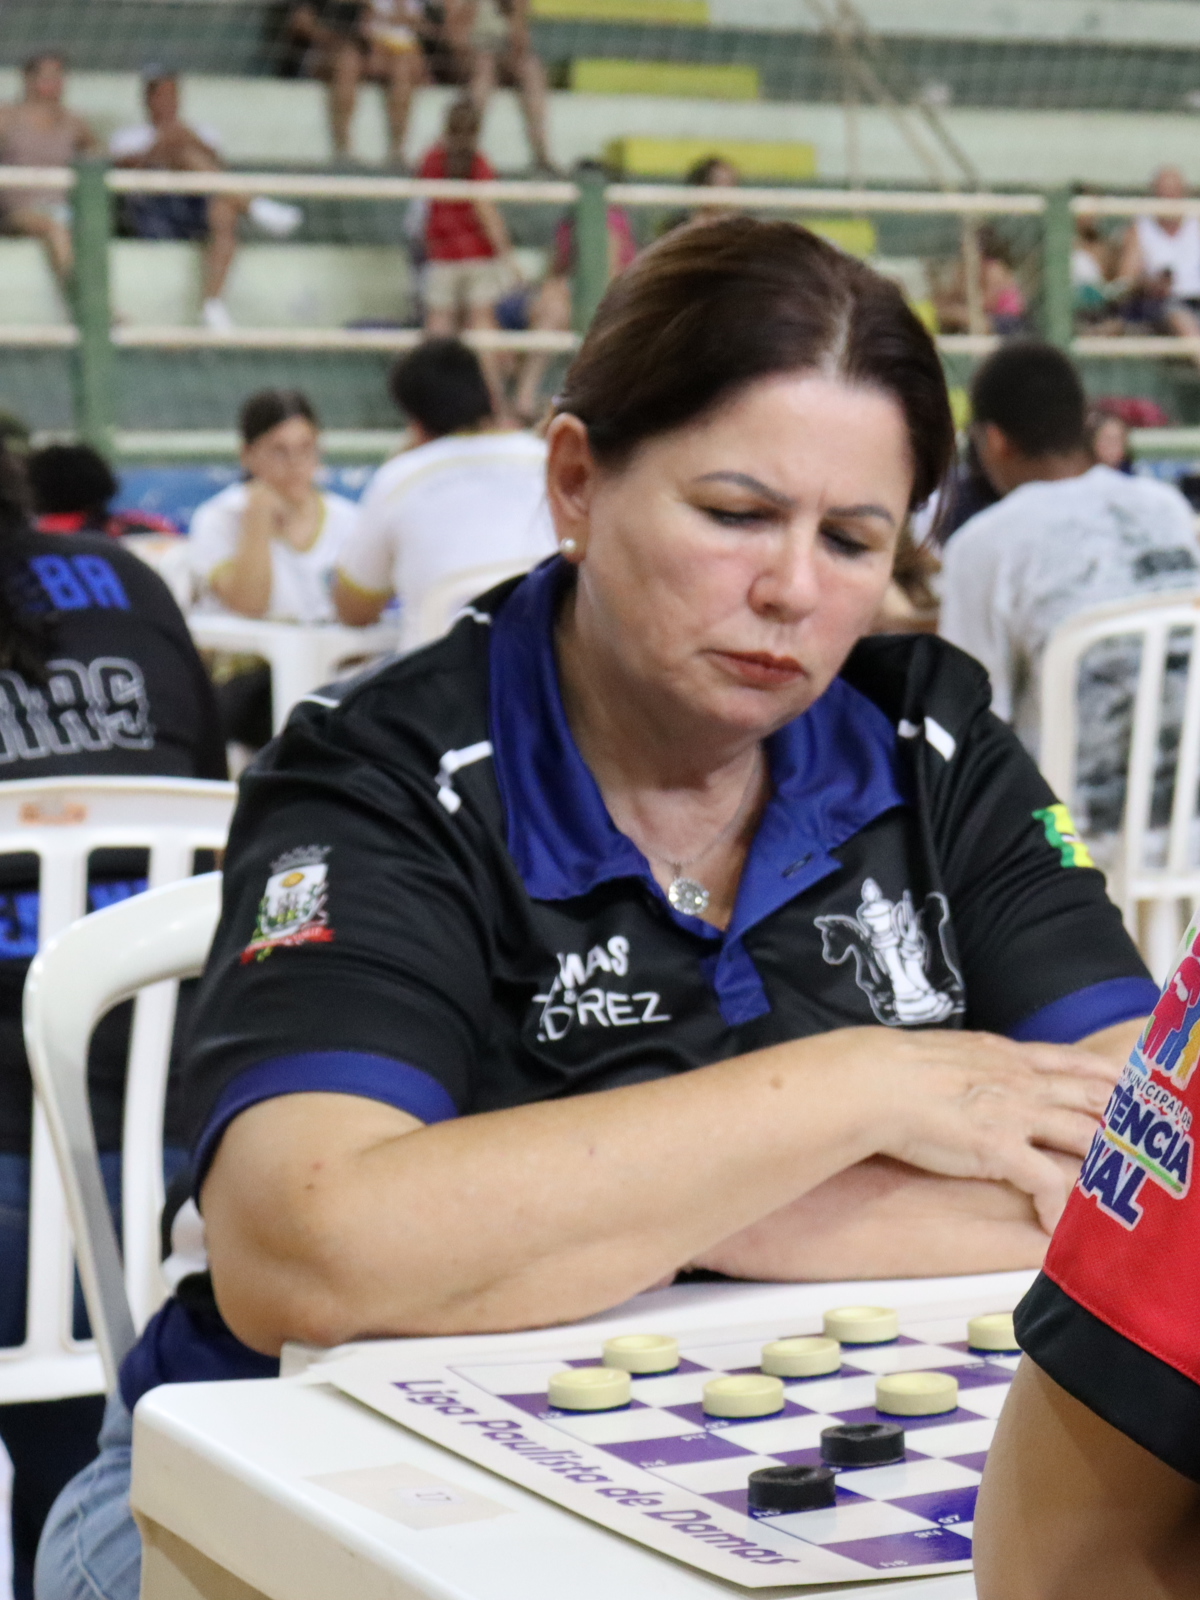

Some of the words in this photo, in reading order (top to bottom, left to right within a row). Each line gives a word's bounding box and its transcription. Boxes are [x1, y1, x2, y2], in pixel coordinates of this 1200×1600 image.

[390, 1379, 480, 1416] Liga
[458, 1419, 614, 1484] Paulista
[595, 1487, 665, 1507] de
[640, 1509, 801, 1565] Damas
